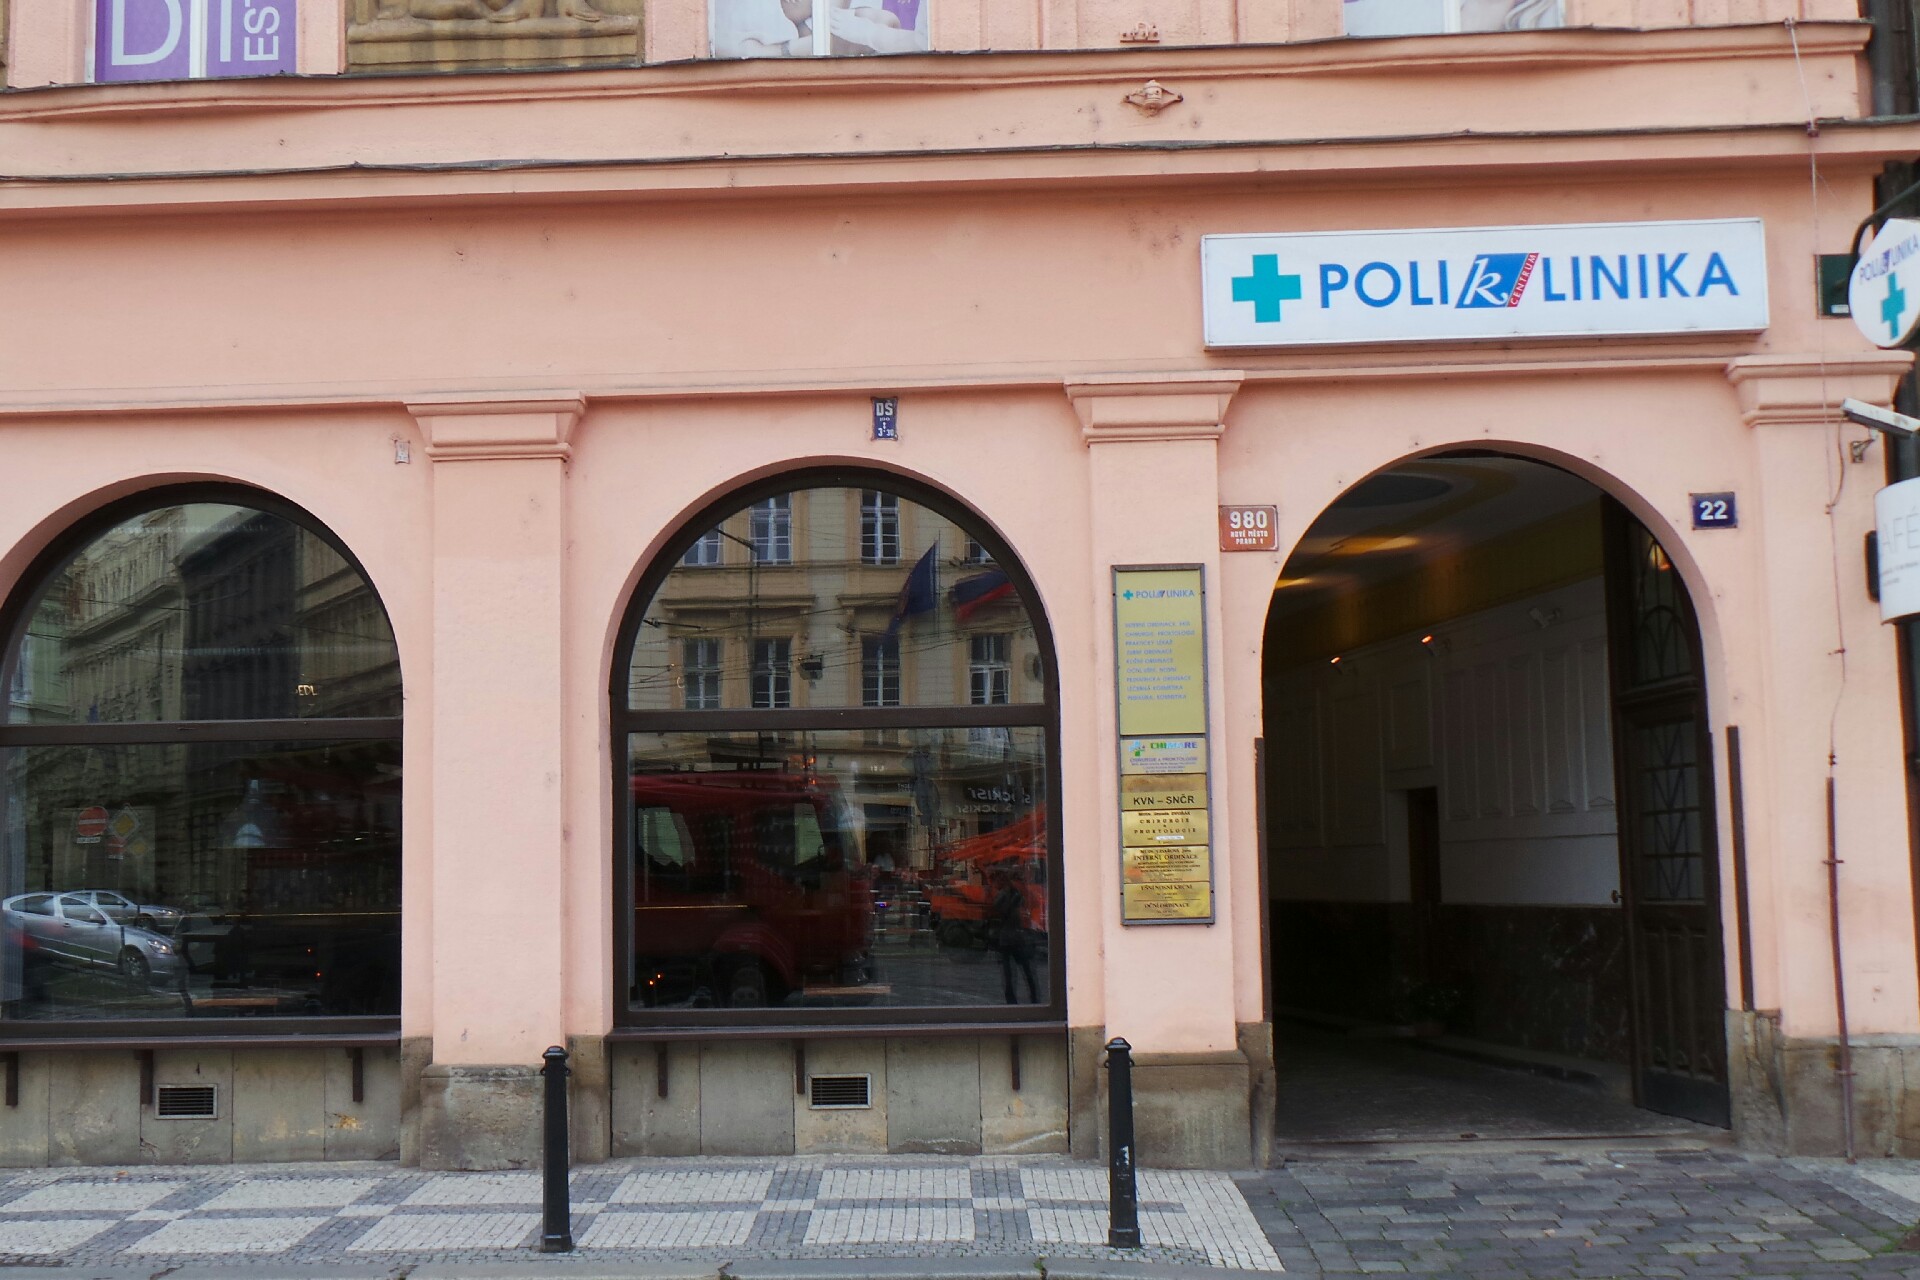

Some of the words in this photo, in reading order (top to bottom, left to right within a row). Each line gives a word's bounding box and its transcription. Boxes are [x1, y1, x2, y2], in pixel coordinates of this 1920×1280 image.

[1510, 254, 1537, 305] CENTRUM
[1700, 500, 1728, 520] 22
[1230, 511, 1267, 529] 980
[1133, 797, 1154, 805] KVN
[1166, 793, 1195, 804] SNČR
